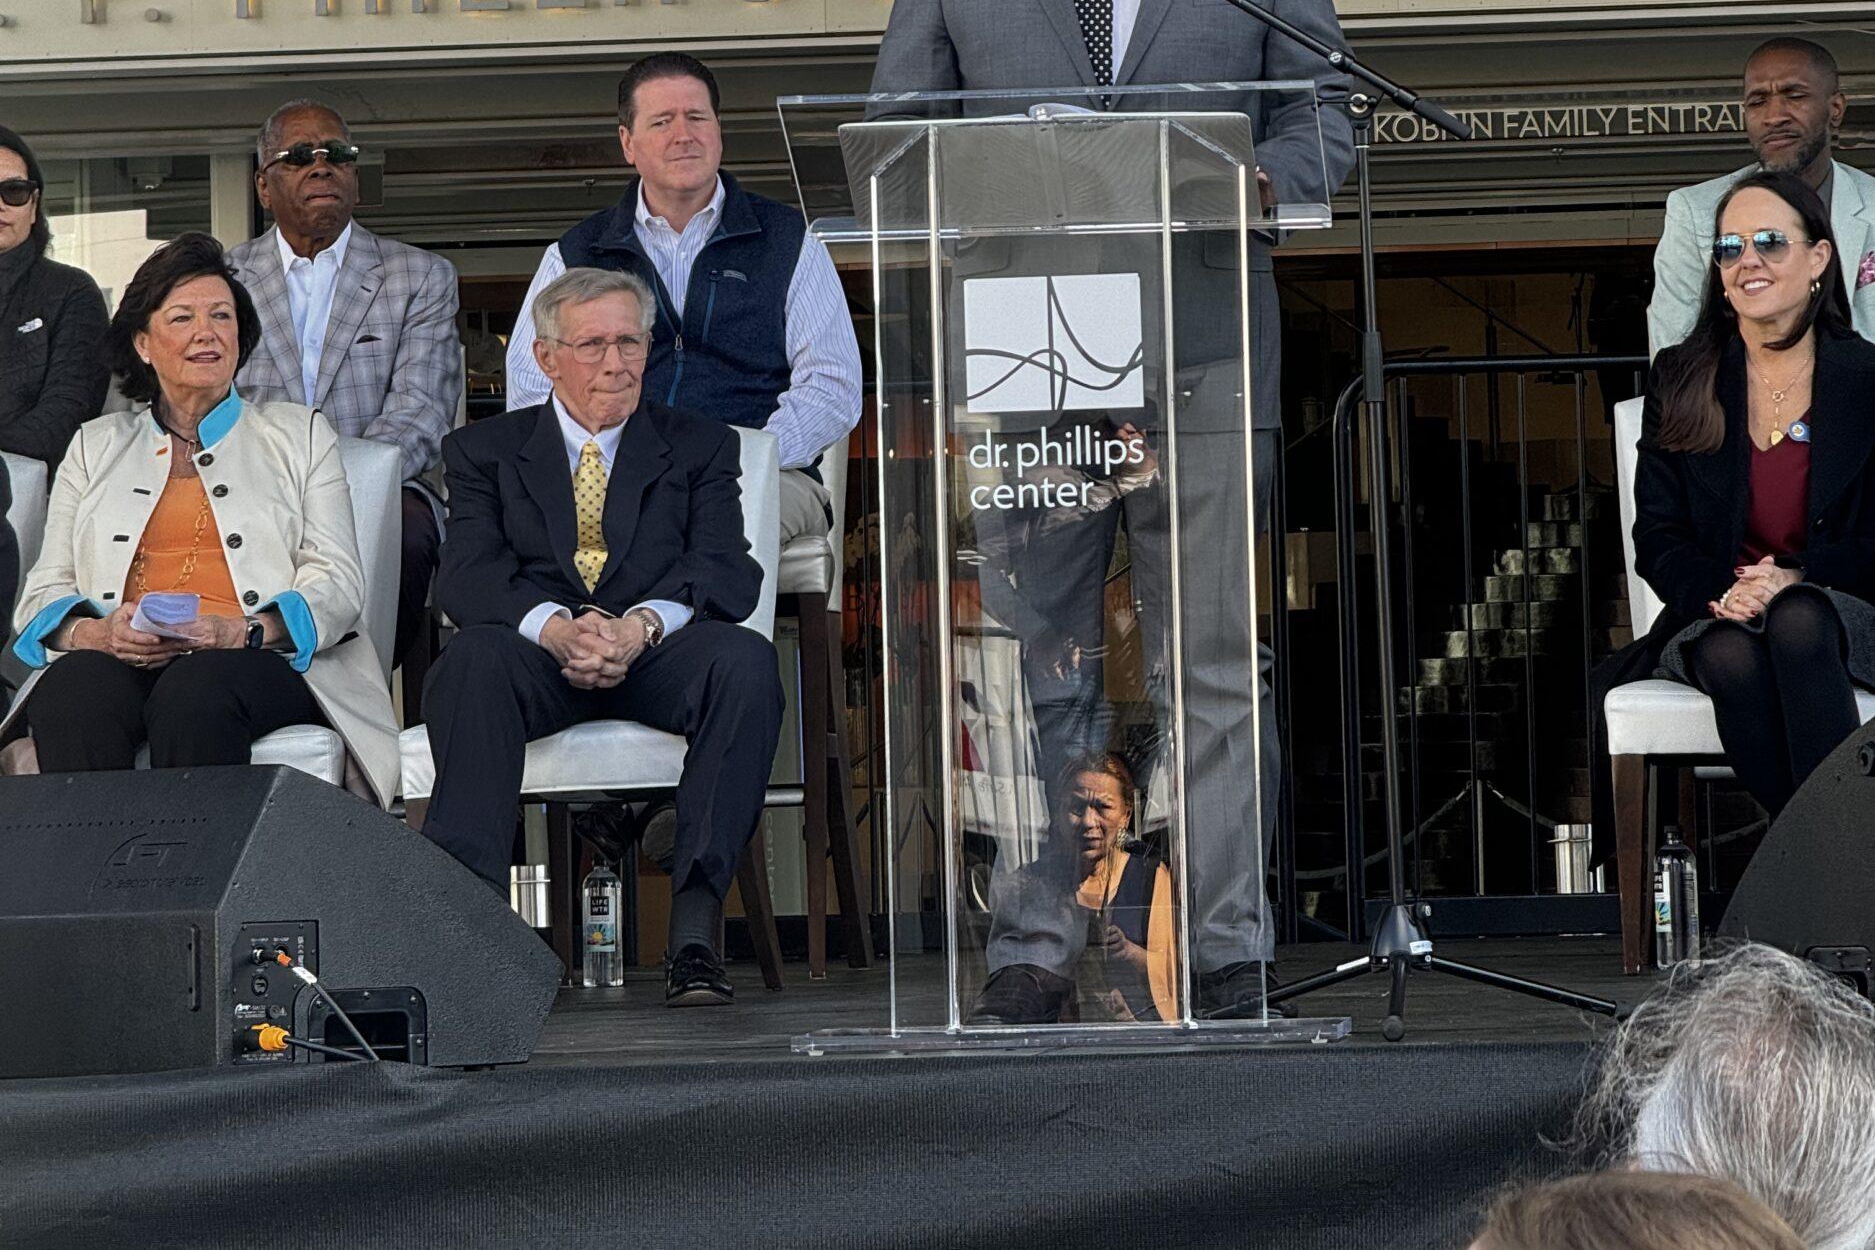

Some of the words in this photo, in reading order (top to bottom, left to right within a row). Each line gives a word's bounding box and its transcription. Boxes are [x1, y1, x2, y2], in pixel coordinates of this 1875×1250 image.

[1503, 106, 1618, 140] FAMILY
[1016, 424, 1145, 478] phillips
[970, 477, 1095, 511] center
[591, 898, 608, 906] LIFE
